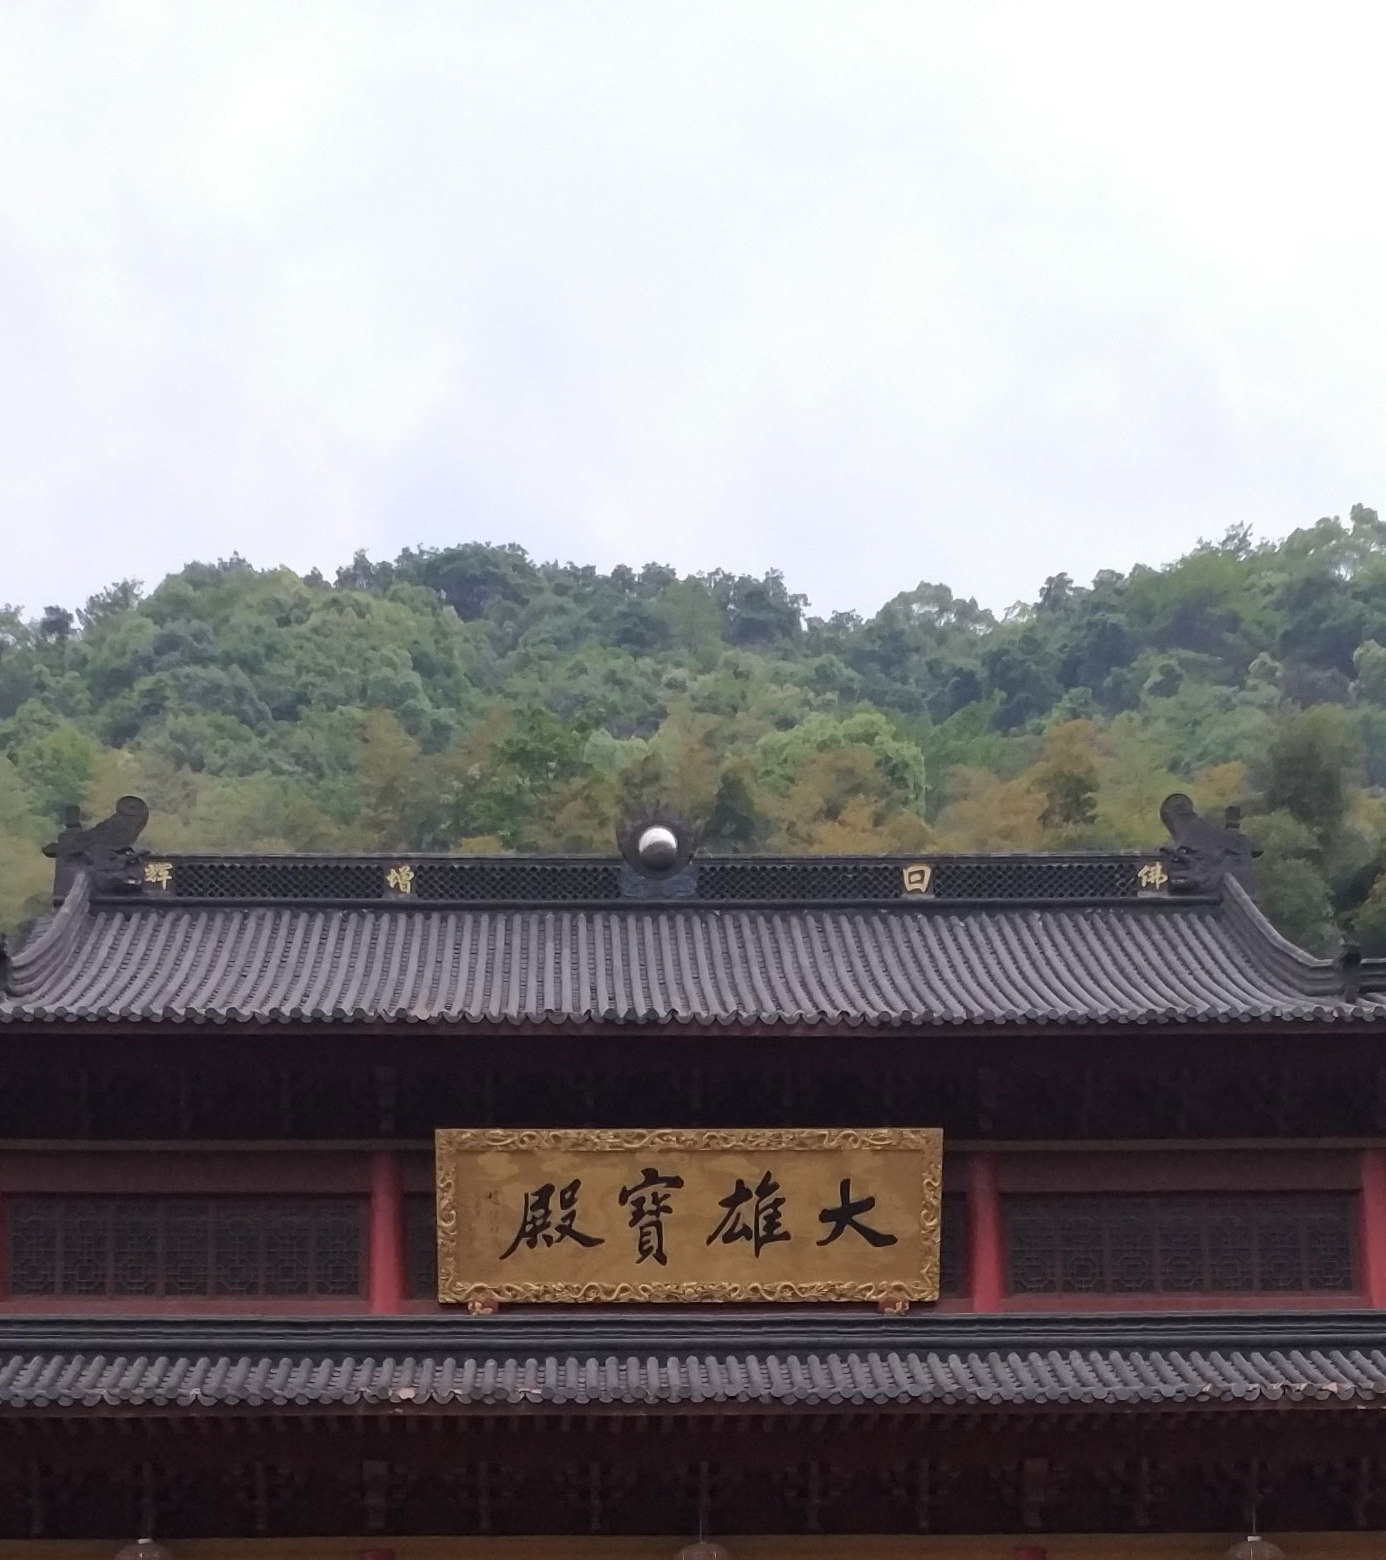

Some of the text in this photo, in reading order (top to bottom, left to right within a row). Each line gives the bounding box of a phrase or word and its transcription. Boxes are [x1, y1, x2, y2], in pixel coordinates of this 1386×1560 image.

[1138, 861, 1169, 890] 佛
[499, 1167, 898, 1266] 大雄寶殿
